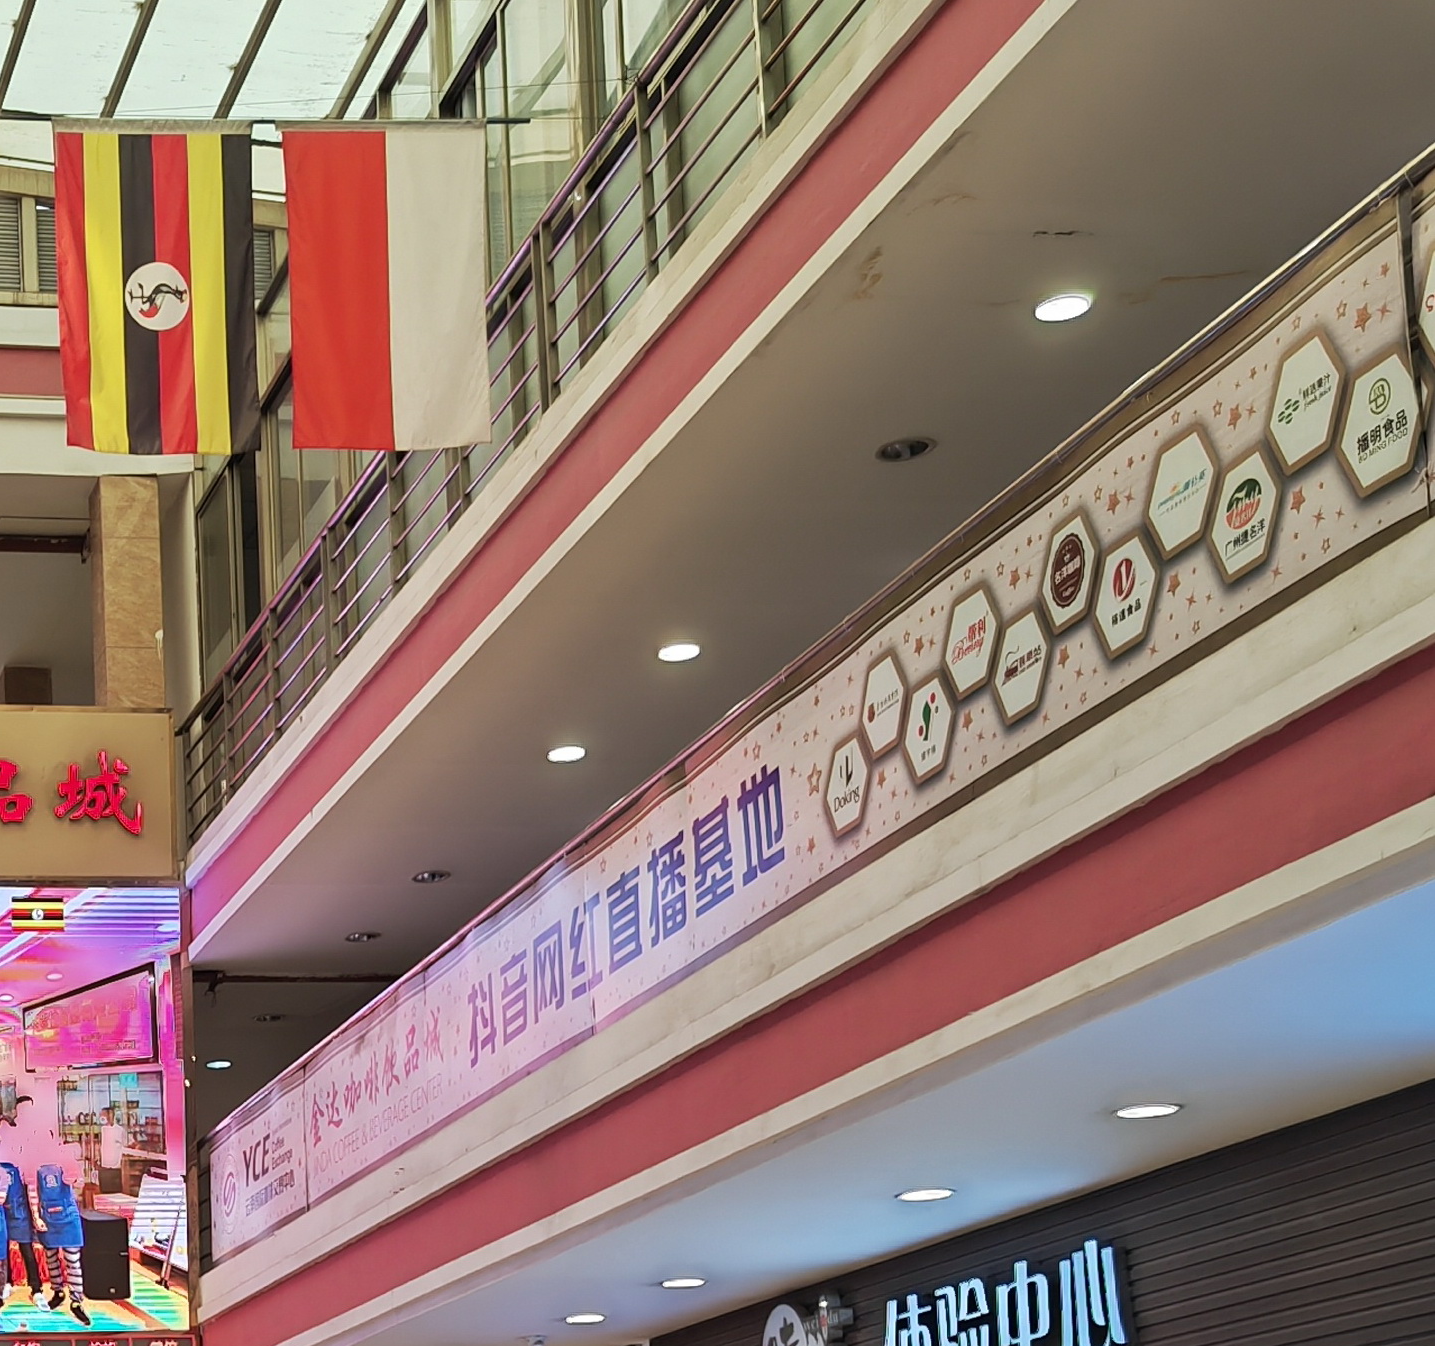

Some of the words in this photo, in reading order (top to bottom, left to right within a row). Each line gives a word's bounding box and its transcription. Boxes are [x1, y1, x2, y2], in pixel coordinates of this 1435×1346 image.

[467, 764, 785, 1069] 抖音网红直播基地
[243, 1133, 270, 1187] YCE
